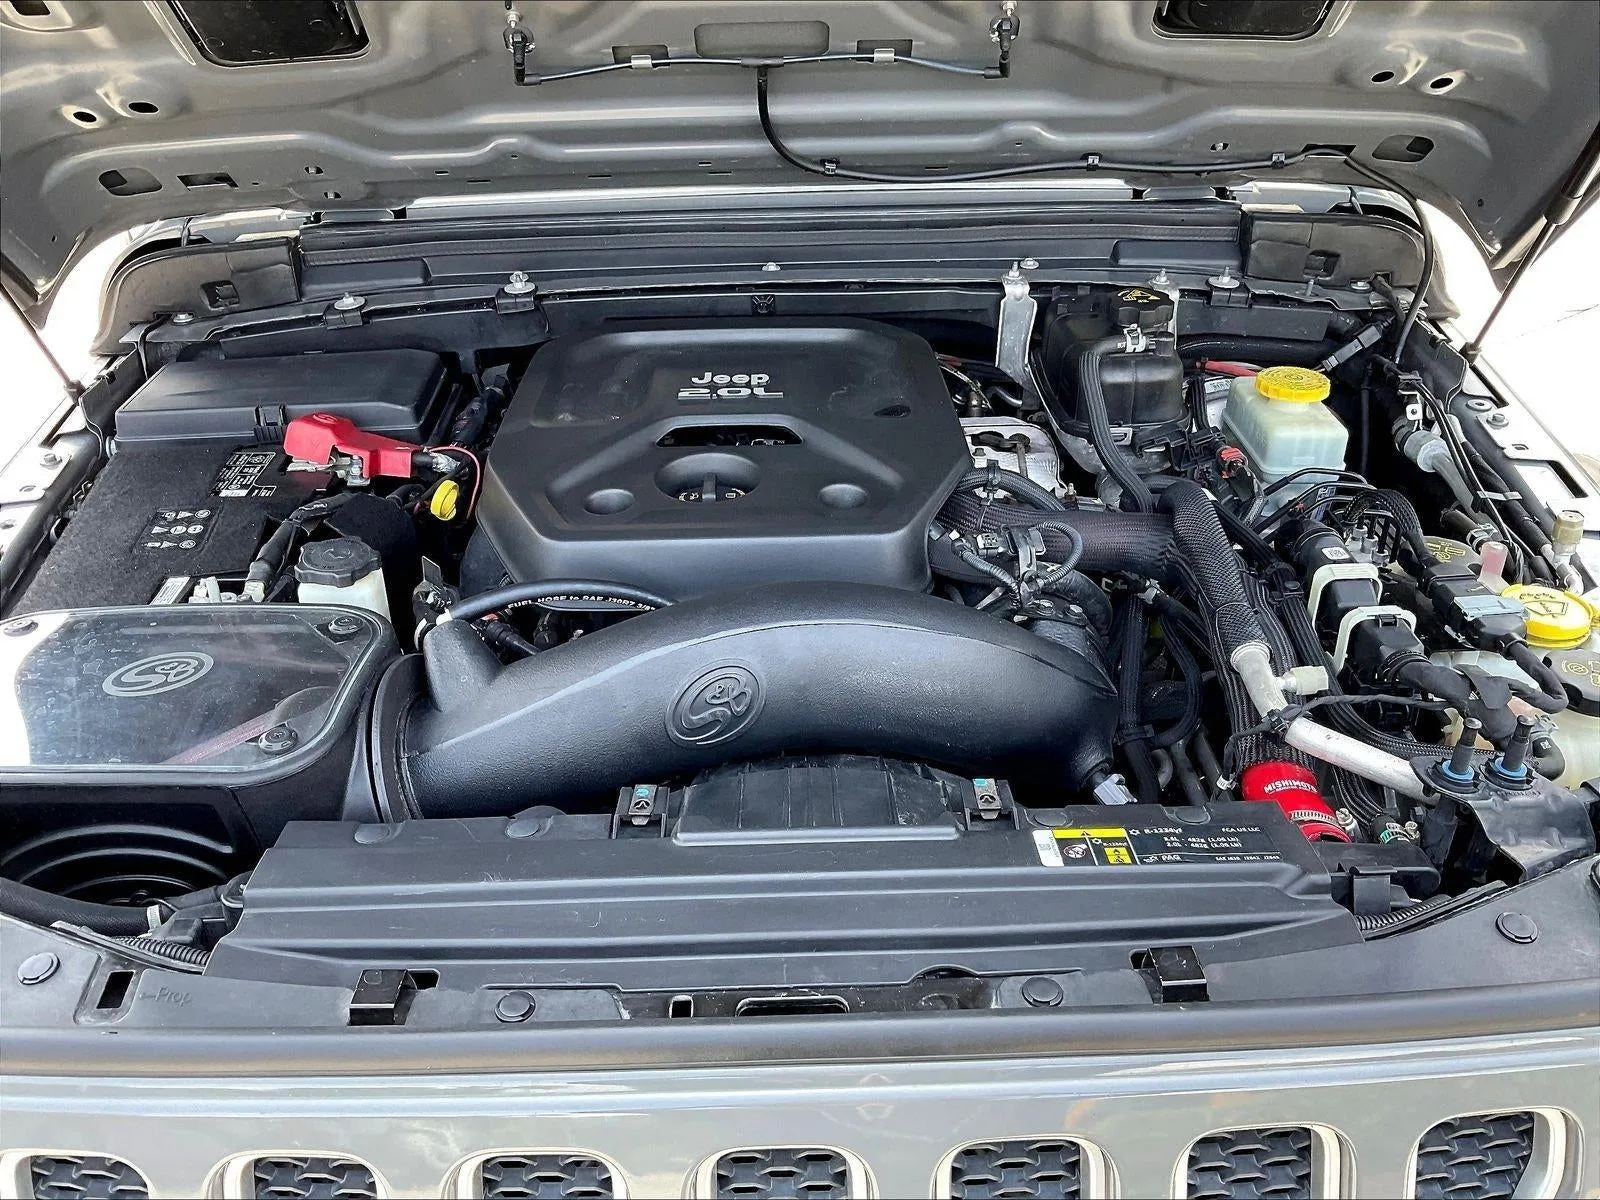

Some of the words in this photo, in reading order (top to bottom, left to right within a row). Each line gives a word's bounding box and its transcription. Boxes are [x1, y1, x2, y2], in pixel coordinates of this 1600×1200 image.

[691, 372, 770, 385] Jeep
[678, 387, 783, 399] 2.0L
[507, 599, 537, 609] FUEL
[1263, 779, 1318, 793] MISHIMOTO
[155, 986, 192, 1007] Prop
